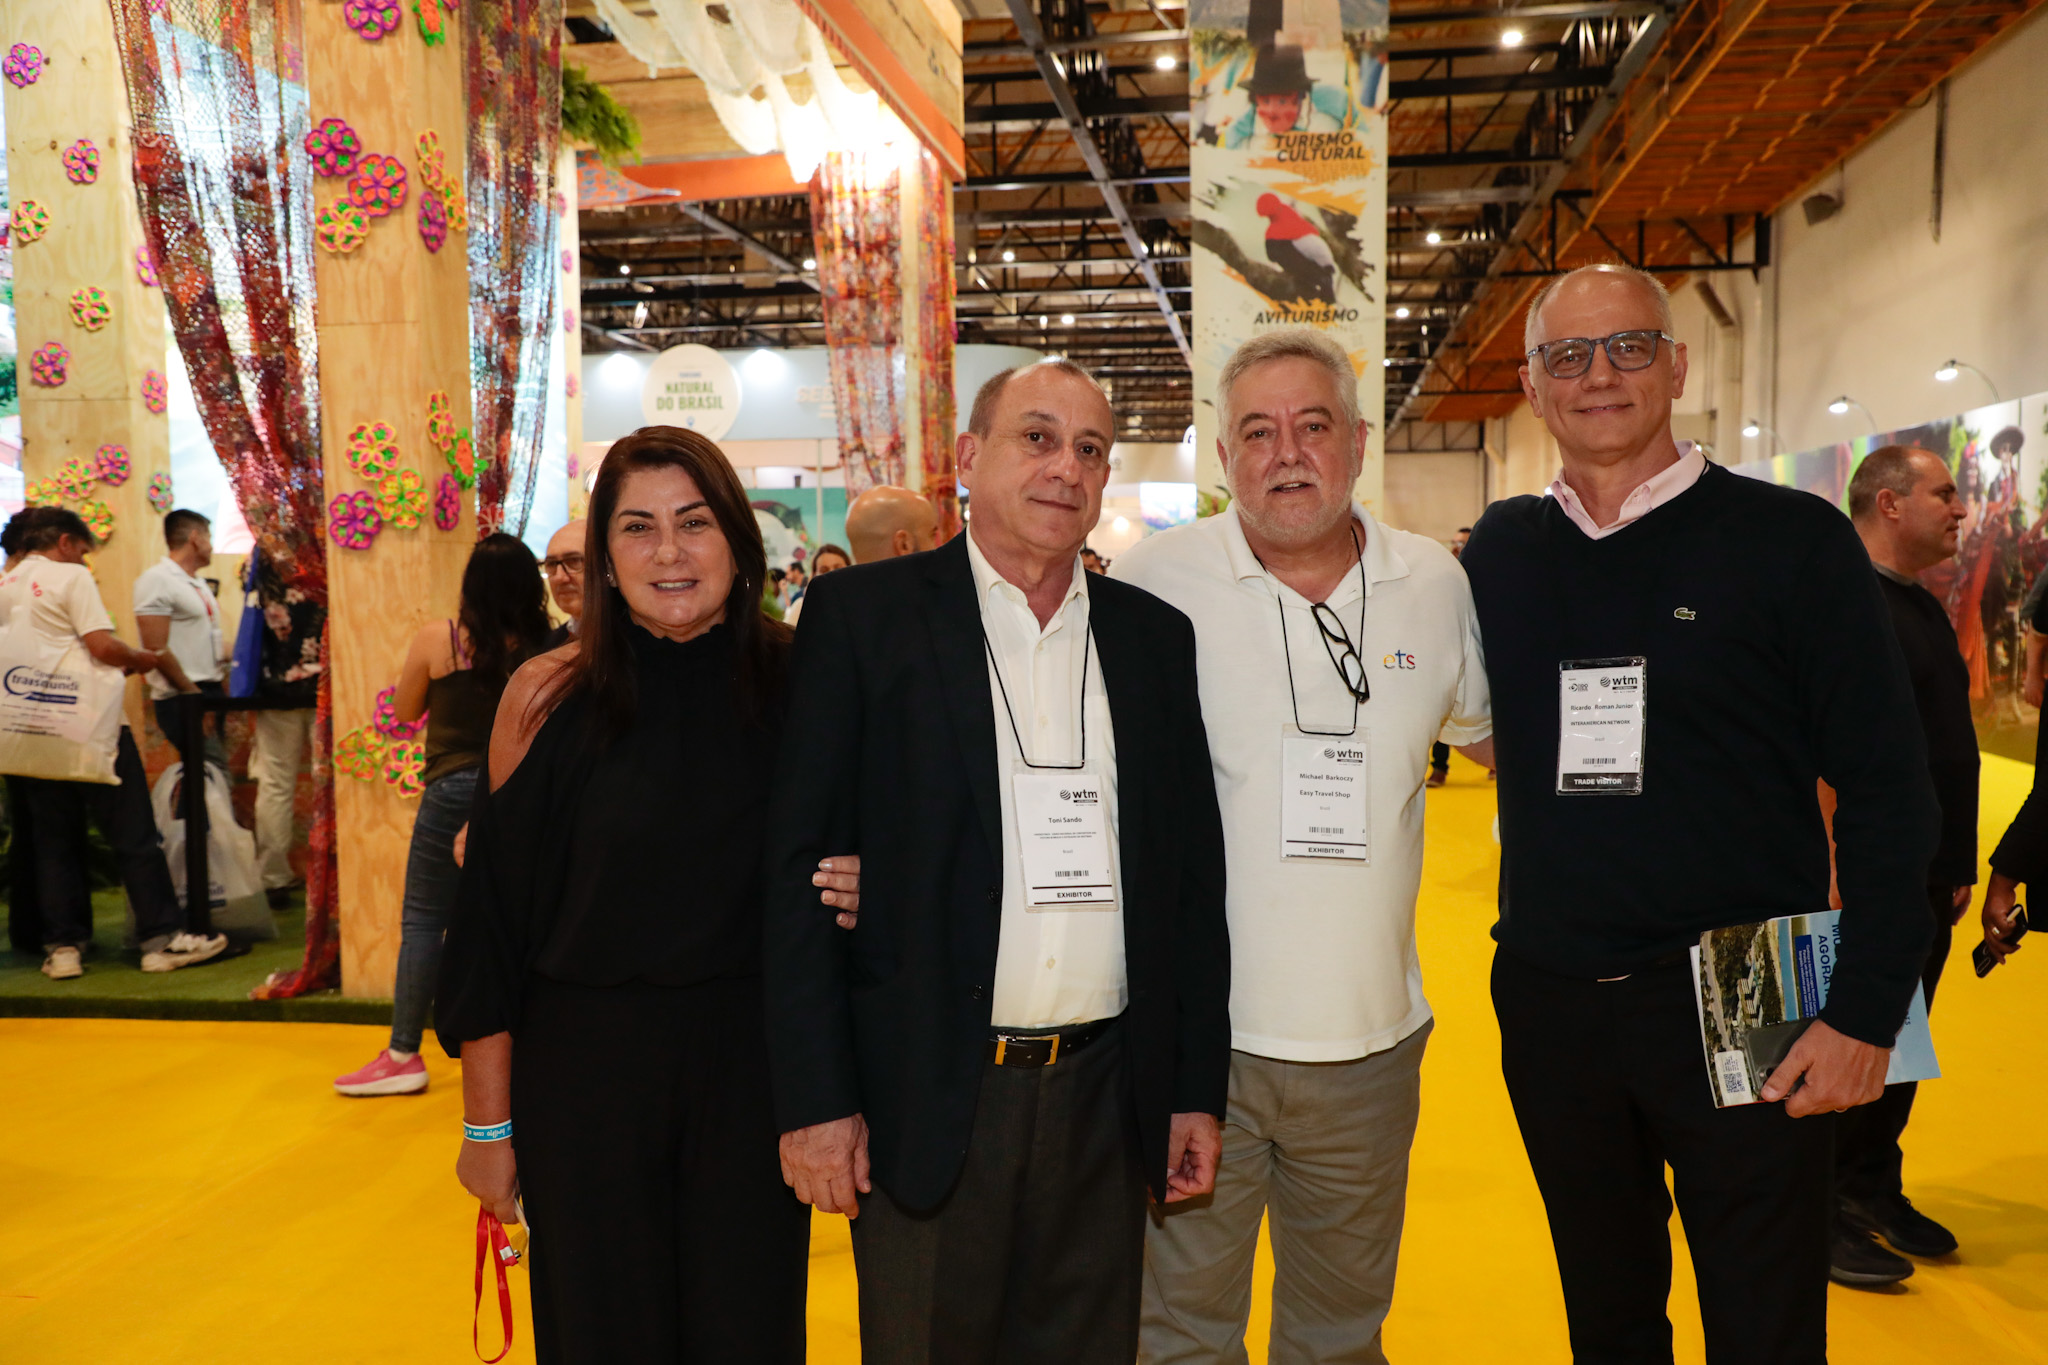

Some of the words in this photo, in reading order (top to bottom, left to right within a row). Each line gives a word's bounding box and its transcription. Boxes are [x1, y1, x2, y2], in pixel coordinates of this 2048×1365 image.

[1275, 132, 1353, 148] TURISMO
[1277, 146, 1366, 162] CULTURAL
[1254, 308, 1359, 324] AVITURISMO
[665, 381, 713, 394] NATURAL
[656, 396, 674, 410] DO
[679, 395, 724, 410] BRASIL
[1383, 649, 1416, 670] ets
[1612, 675, 1638, 685] wtm
[1337, 748, 1363, 758] wtm
[1326, 774, 1354, 782] Barkoczy
[1072, 788, 1098, 798] wtm
[1299, 789, 1314, 797] Easy
[1308, 847, 1345, 855] EXHIBITOR
[1818, 935, 1832, 985] AGORA
